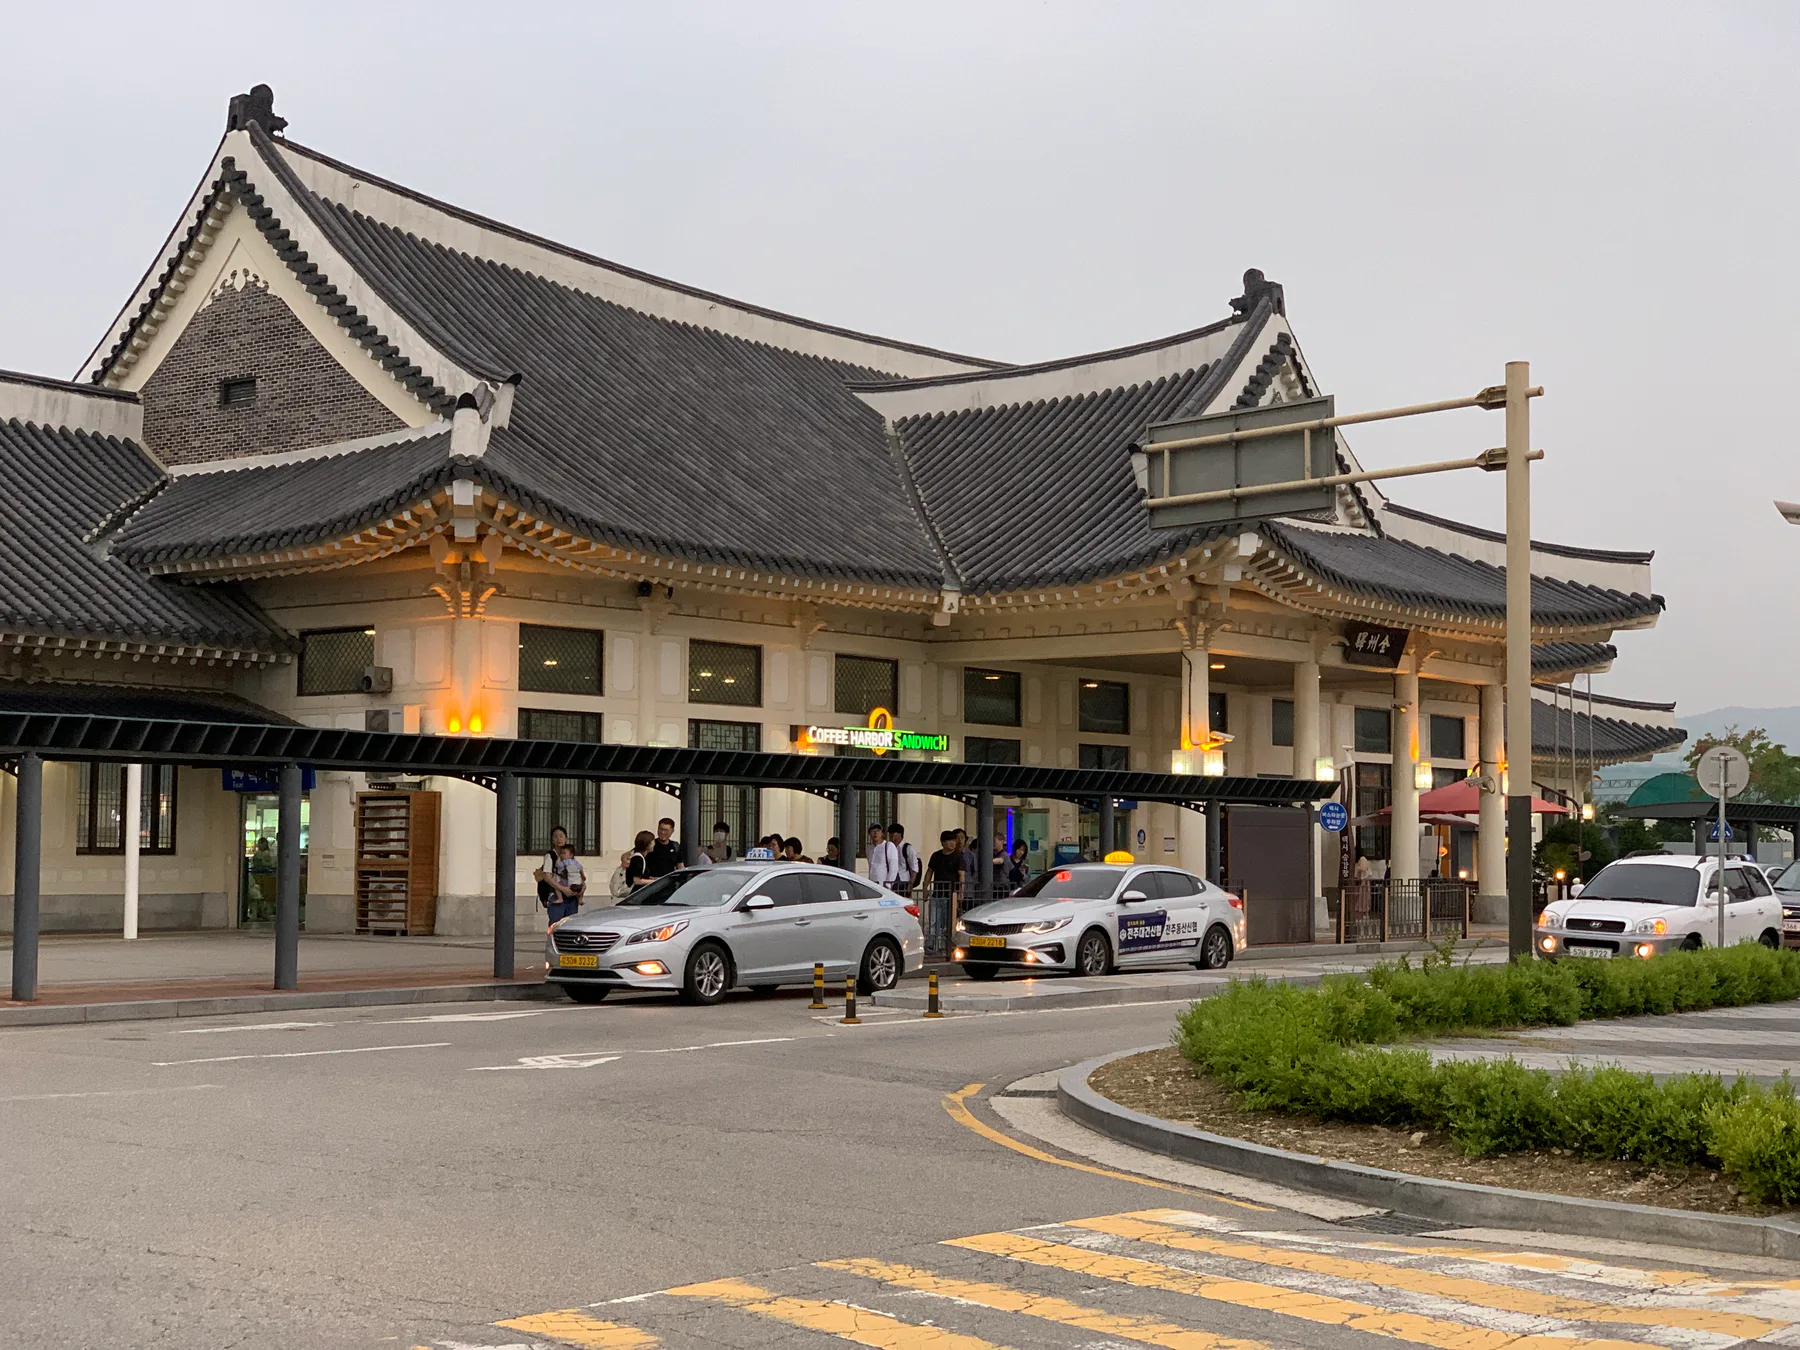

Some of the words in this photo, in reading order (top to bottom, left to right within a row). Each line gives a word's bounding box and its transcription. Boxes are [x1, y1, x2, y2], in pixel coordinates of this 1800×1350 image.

[850, 729, 893, 747] HARBOR
[1341, 853, 1350, 878] 승강장
[1589, 949, 1608, 958] 8722
[578, 956, 595, 966] 3232
